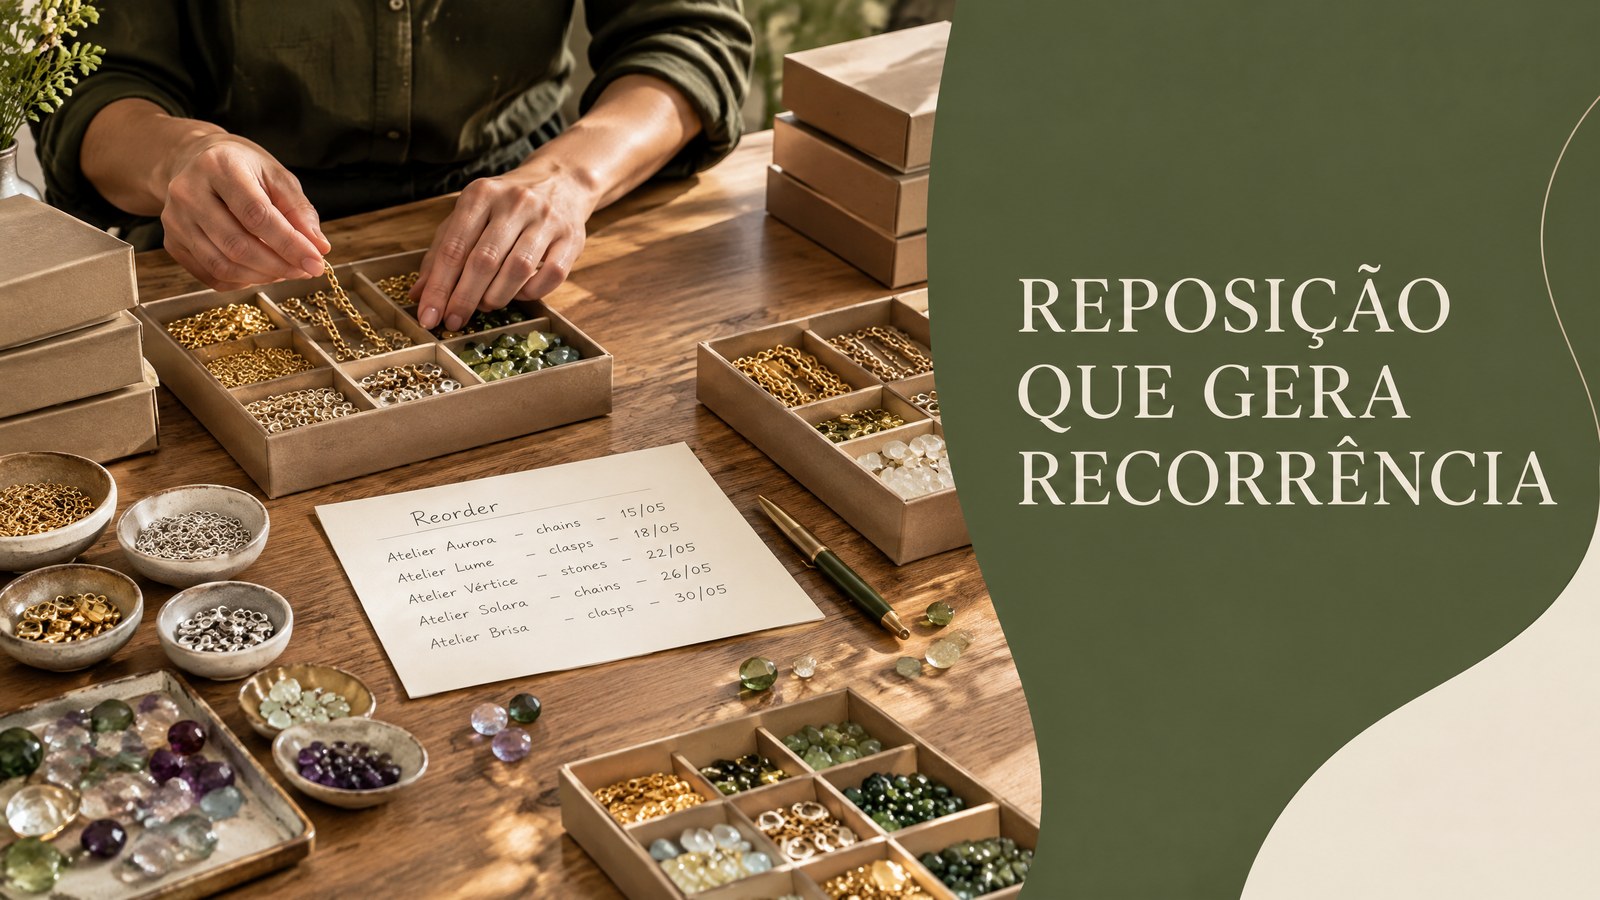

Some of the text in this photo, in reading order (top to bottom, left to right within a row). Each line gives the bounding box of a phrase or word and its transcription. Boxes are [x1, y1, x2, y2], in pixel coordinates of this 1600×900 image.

[387, 547, 437, 564] Atelier
[446, 537, 497, 553] Aurora
[536, 520, 581, 535] chains
[620, 502, 666, 519] 15/05
[409, 501, 499, 527] Reorder
[397, 568, 447, 584] Atelier
[454, 559, 495, 573] Lume
[548, 540, 594, 555] clasps
[633, 521, 680, 539] 18/05
[408, 589, 457, 605] Atelier
[463, 578, 519, 594] Vértice
[560, 561, 608, 576] stones
[645, 542, 696, 560] 22/05
[419, 610, 470, 627] Atelier
[478, 600, 529, 616] Solara
[574, 582, 621, 598] chains
[660, 562, 712, 582] 26/05
[430, 633, 480, 650] Atelier
[488, 625, 531, 639] Brisa
[587, 604, 635, 620] clasps
[674, 583, 727, 603] 30/05
